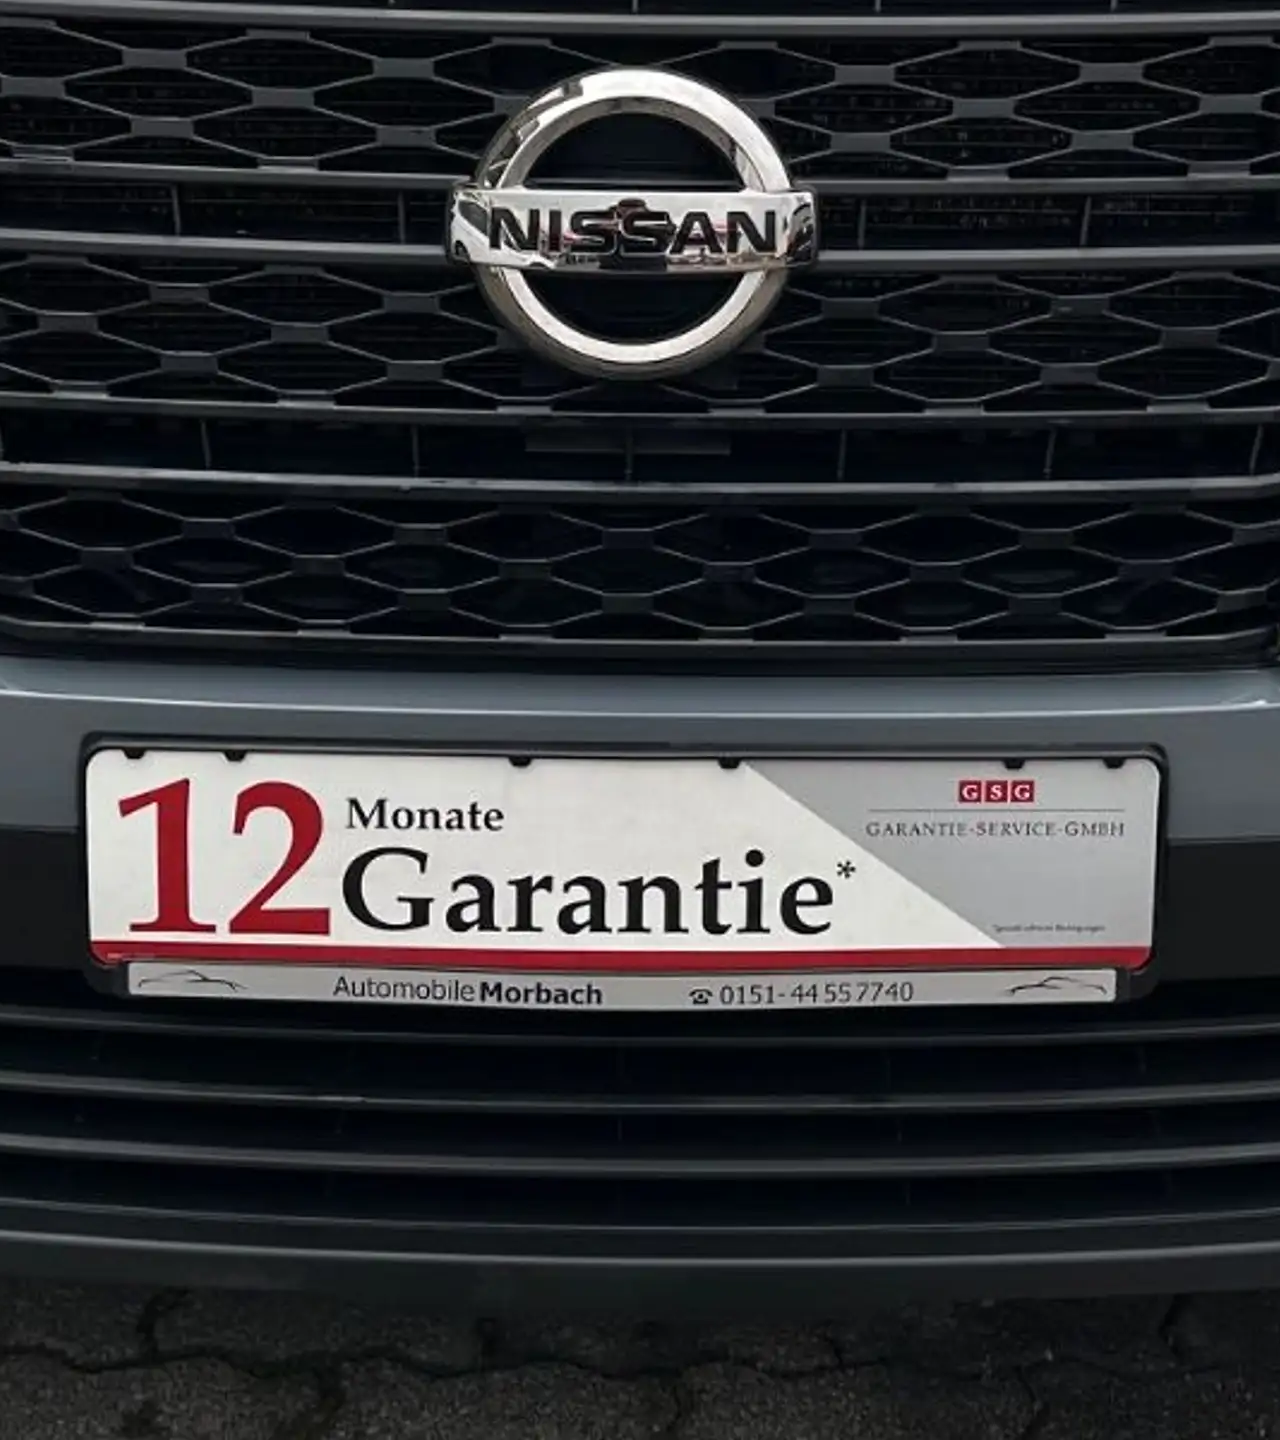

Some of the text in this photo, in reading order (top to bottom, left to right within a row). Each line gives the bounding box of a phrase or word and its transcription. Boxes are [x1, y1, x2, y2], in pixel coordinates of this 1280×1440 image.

[488, 207, 777, 254] NISSAN
[960, 783, 1032, 801] GSG
[345, 797, 505, 831] Monate
[118, 778, 331, 935] 12
[333, 976, 603, 1006] Automobile Morbach
